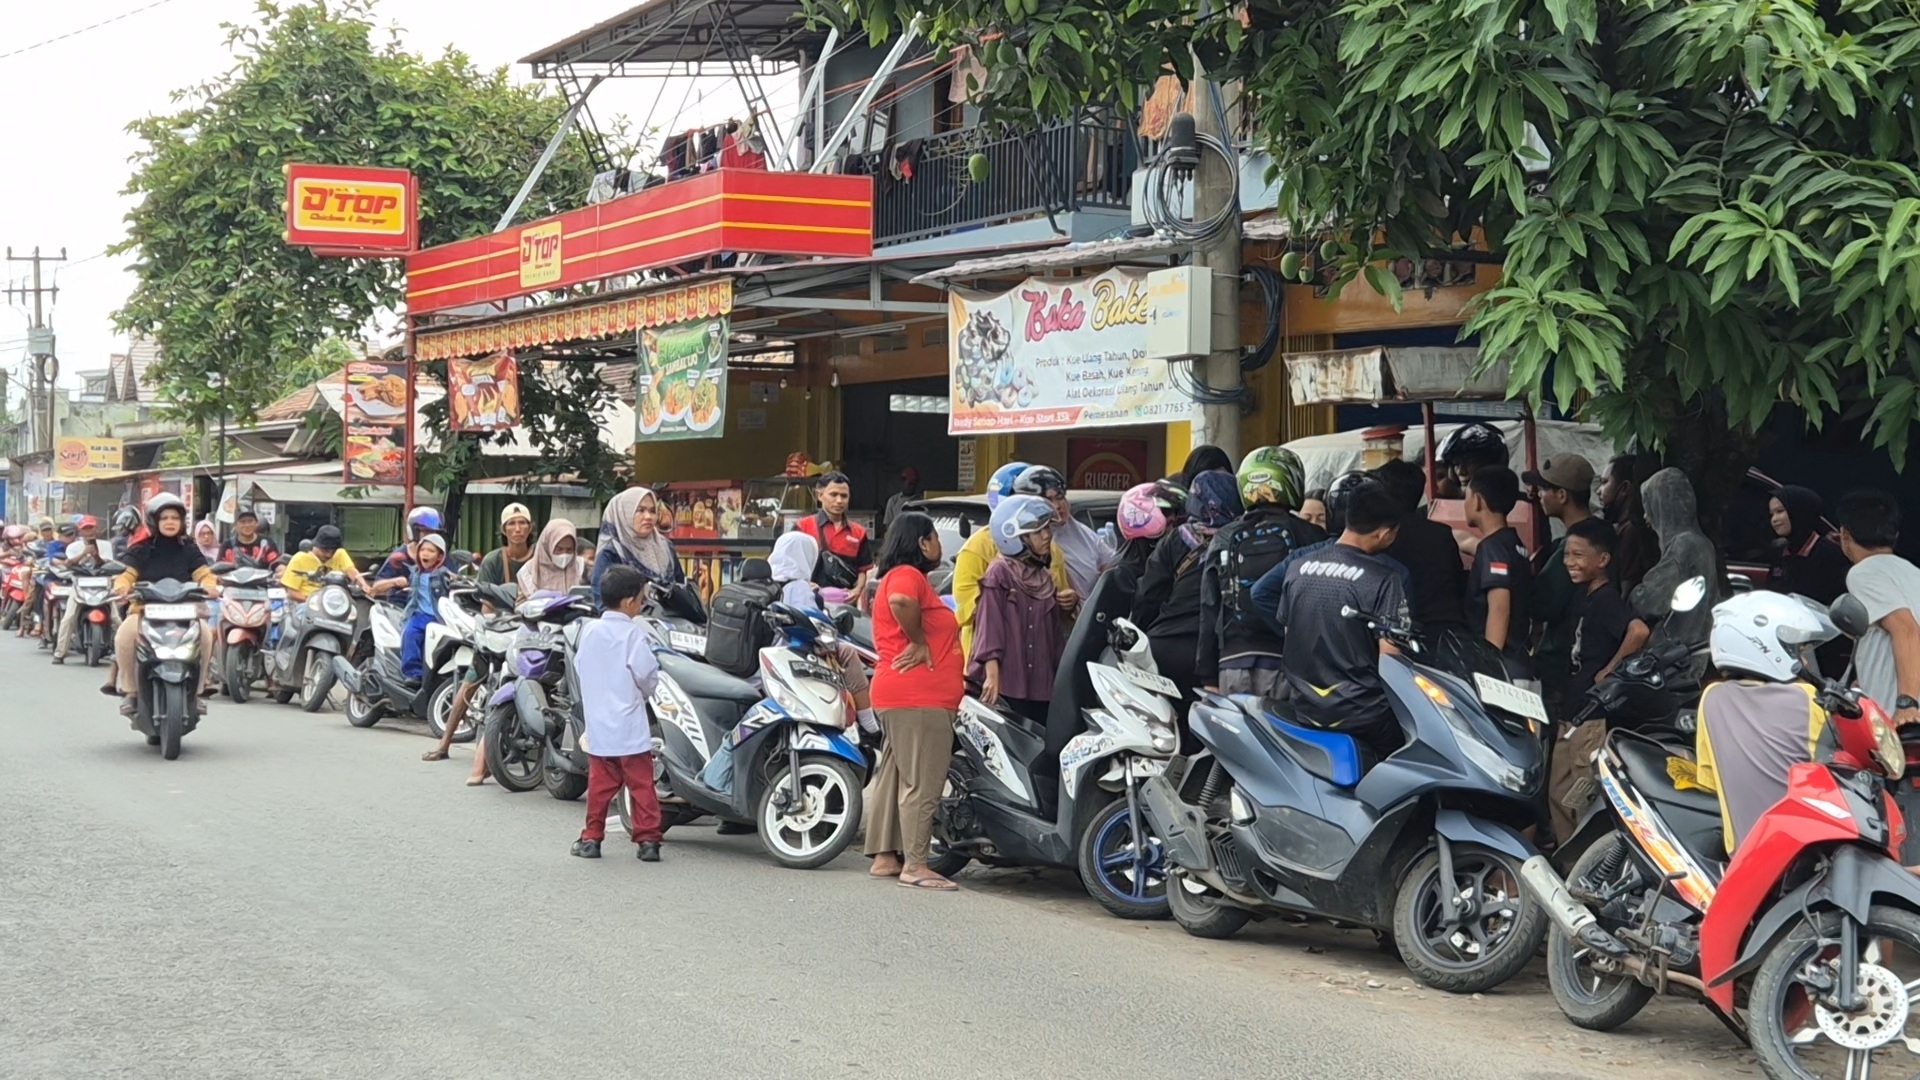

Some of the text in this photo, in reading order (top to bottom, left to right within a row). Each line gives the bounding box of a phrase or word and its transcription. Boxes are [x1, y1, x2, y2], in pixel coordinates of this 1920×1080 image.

[302, 187, 397, 214] D'TOP
[522, 234, 558, 262] D'TOP
[1066, 354, 1081, 366] Kue
[1065, 370, 1081, 381] Kue
[1107, 368, 1124, 379] Kue
[1139, 381, 1165, 392] Tahun
